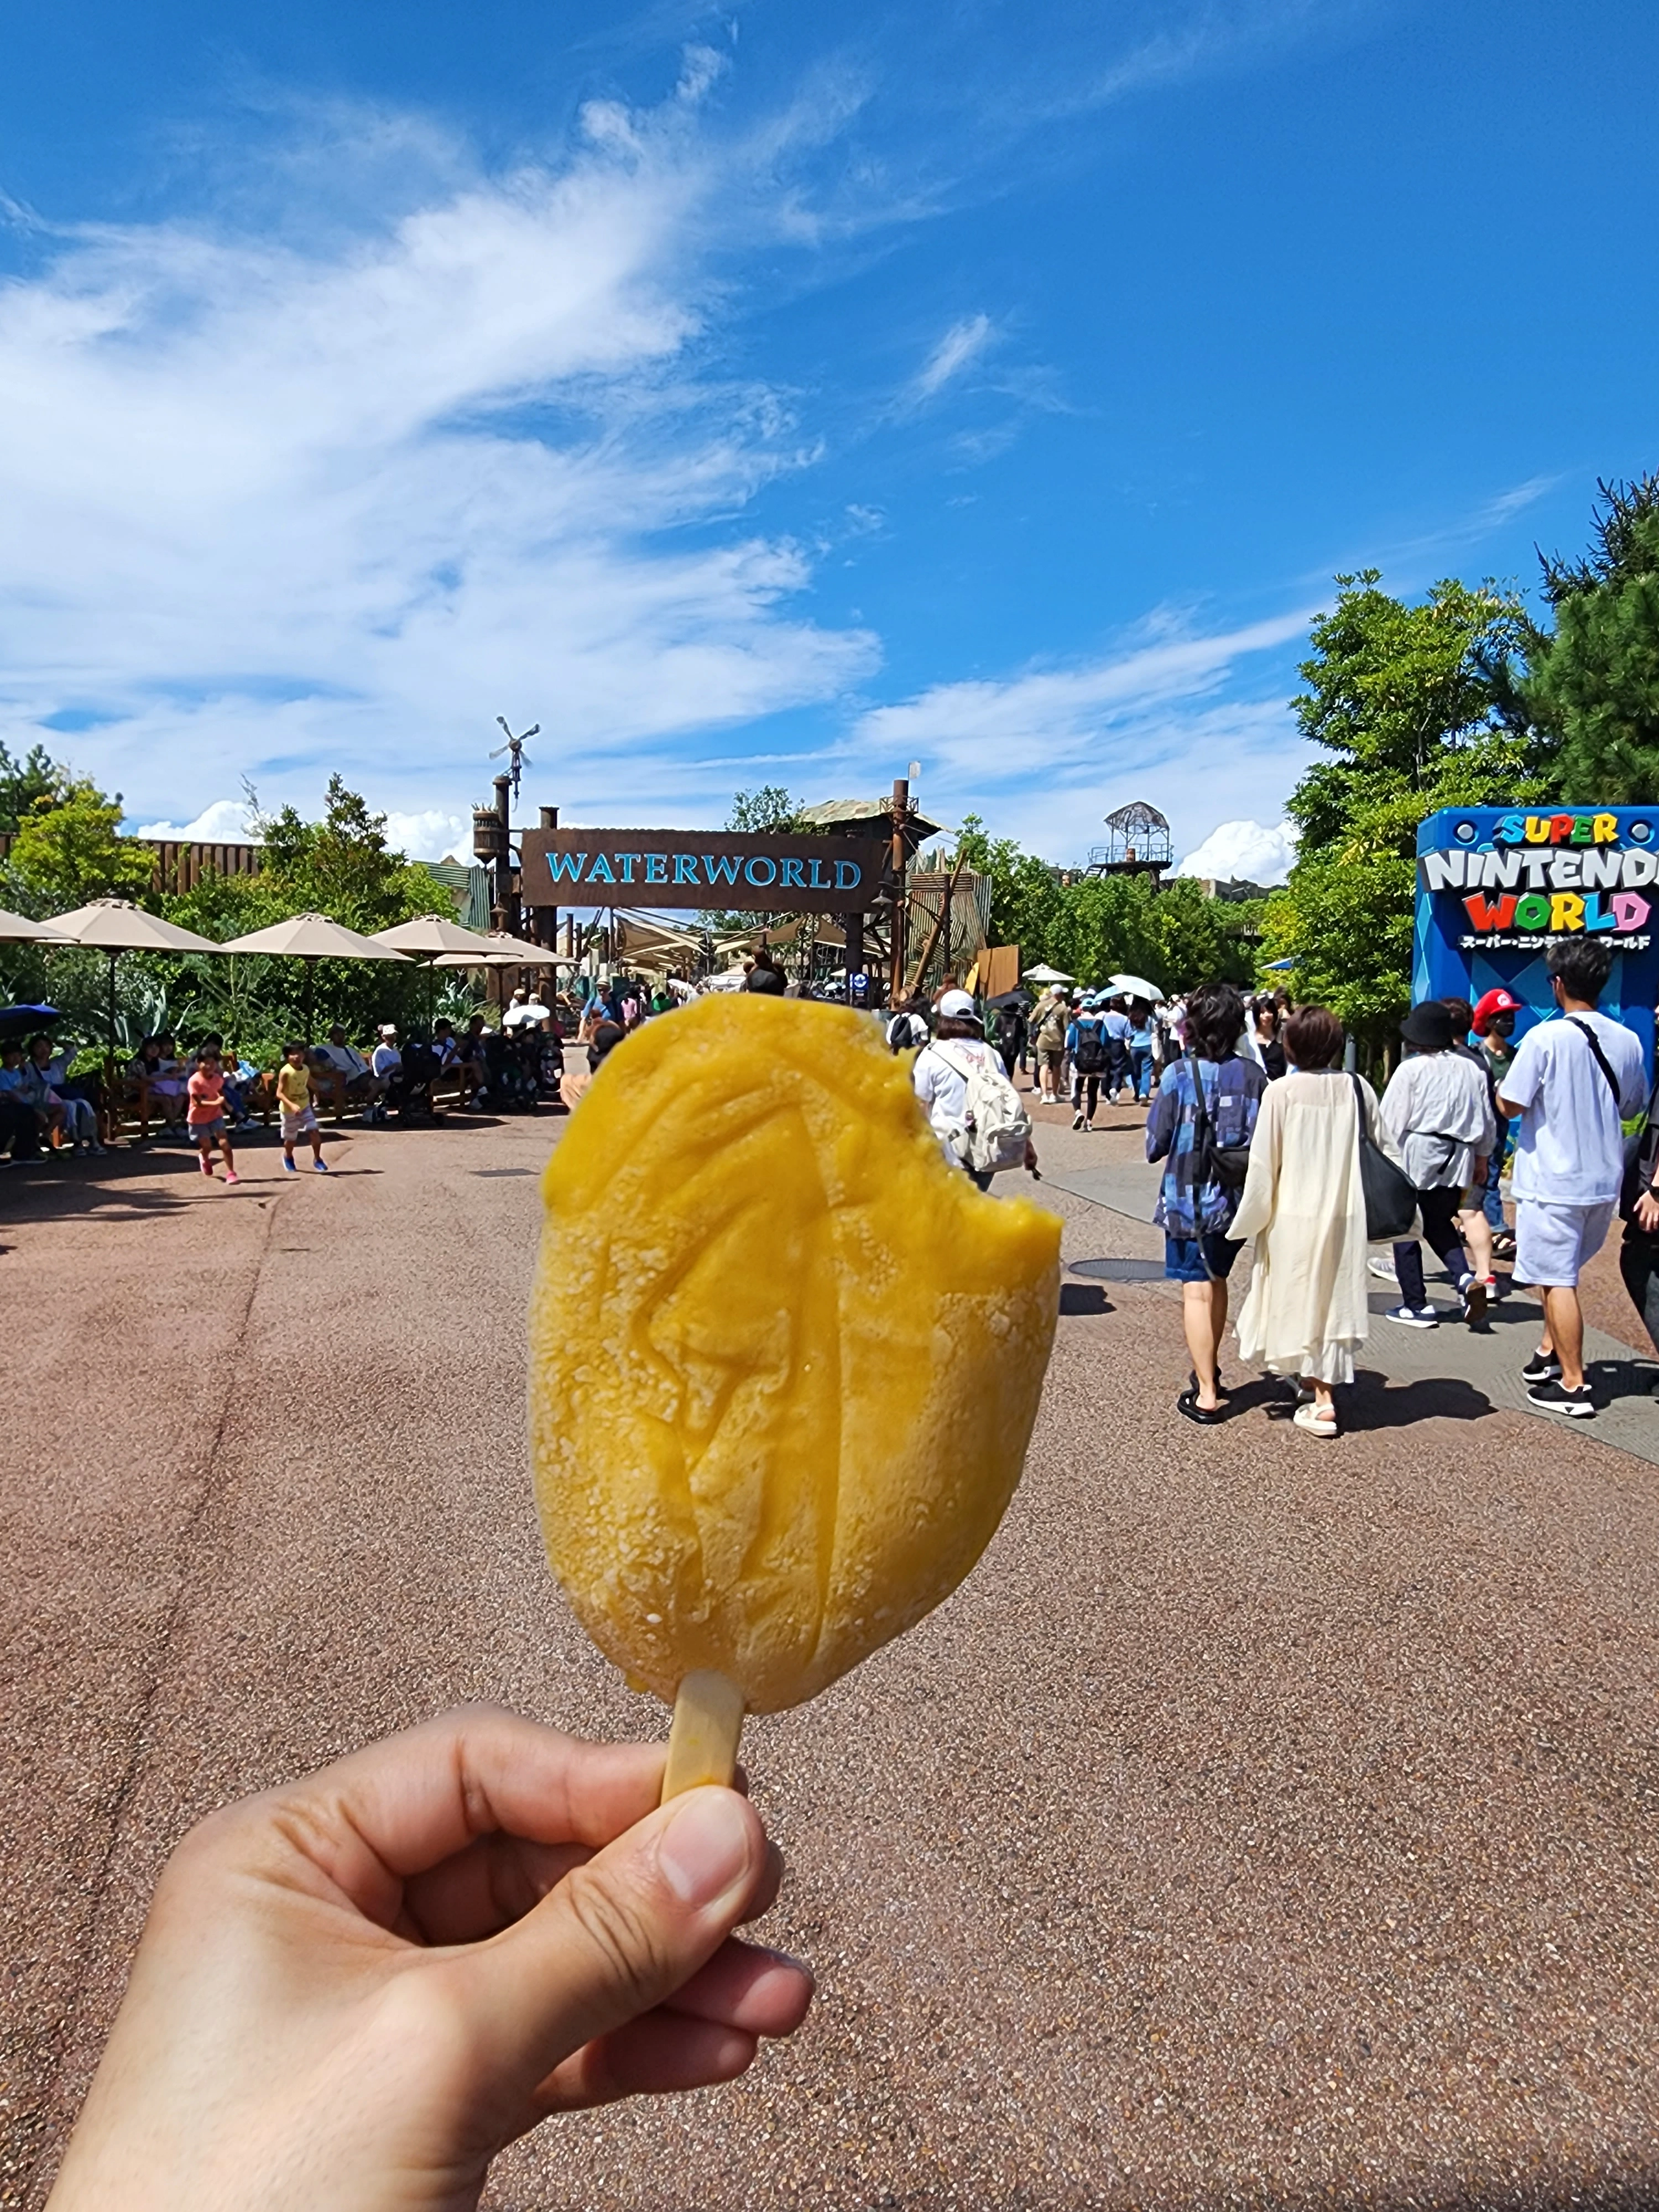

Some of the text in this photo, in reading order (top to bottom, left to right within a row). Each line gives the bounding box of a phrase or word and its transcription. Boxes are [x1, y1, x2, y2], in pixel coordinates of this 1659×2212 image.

[1495, 813, 1620, 844] SUPER
[545, 853, 861, 889] WATERWORLD
[1423, 847, 1659, 890] NINTEND
[1463, 891, 1652, 932] WORLD
